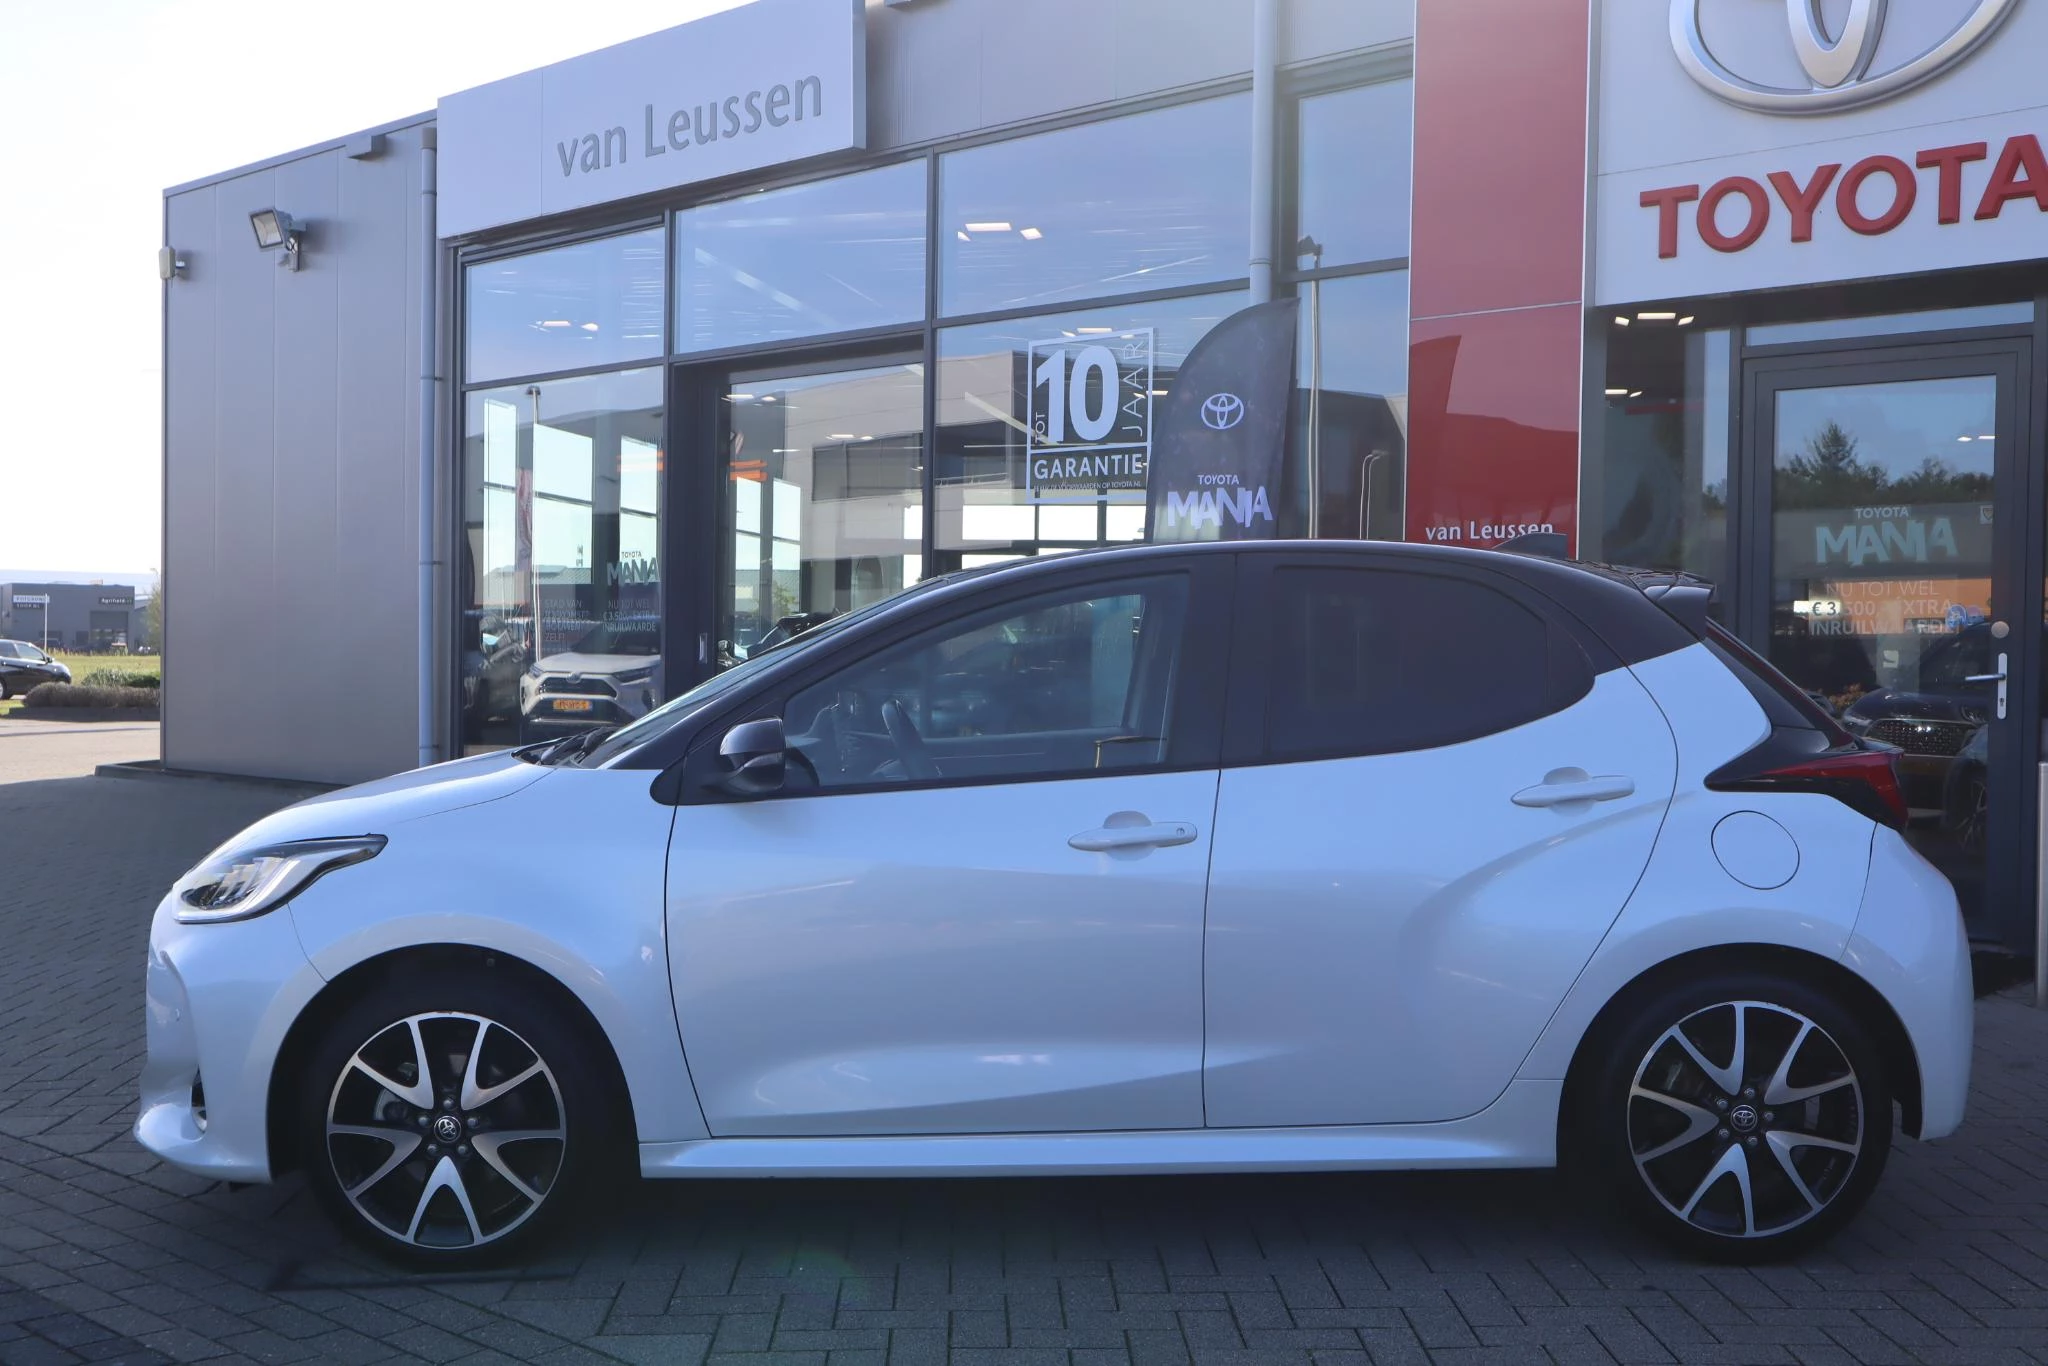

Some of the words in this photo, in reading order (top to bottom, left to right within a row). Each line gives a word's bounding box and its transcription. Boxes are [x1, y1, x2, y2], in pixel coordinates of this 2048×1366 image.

[557, 126, 627, 177] van
[645, 75, 822, 158] Leussen
[1640, 134, 2048, 260] TOYOTA
[1035, 345, 1119, 443] 10
[1122, 341, 1144, 437] JAAR
[1035, 411, 1046, 443] TOT
[1034, 453, 1143, 480] GARANTIE
[1197, 474, 1240, 486] TOYOTA
[1167, 486, 1273, 529] MANIA
[1855, 506, 1910, 519] TOYOTA
[1425, 526, 1461, 541] van
[1815, 518, 1960, 566] MANIA
[621, 551, 642, 559] TOYOTA
[606, 557, 660, 587] MANIA
[1826, 582, 1852, 598] NU
[1859, 581, 1894, 597] TOT
[1898, 580, 1940, 596] WEL
[1827, 600, 1884, 618] 3.500,
[1896, 599, 1952, 615] XTRA
[1811, 619, 1958, 636] INRUILWARD
